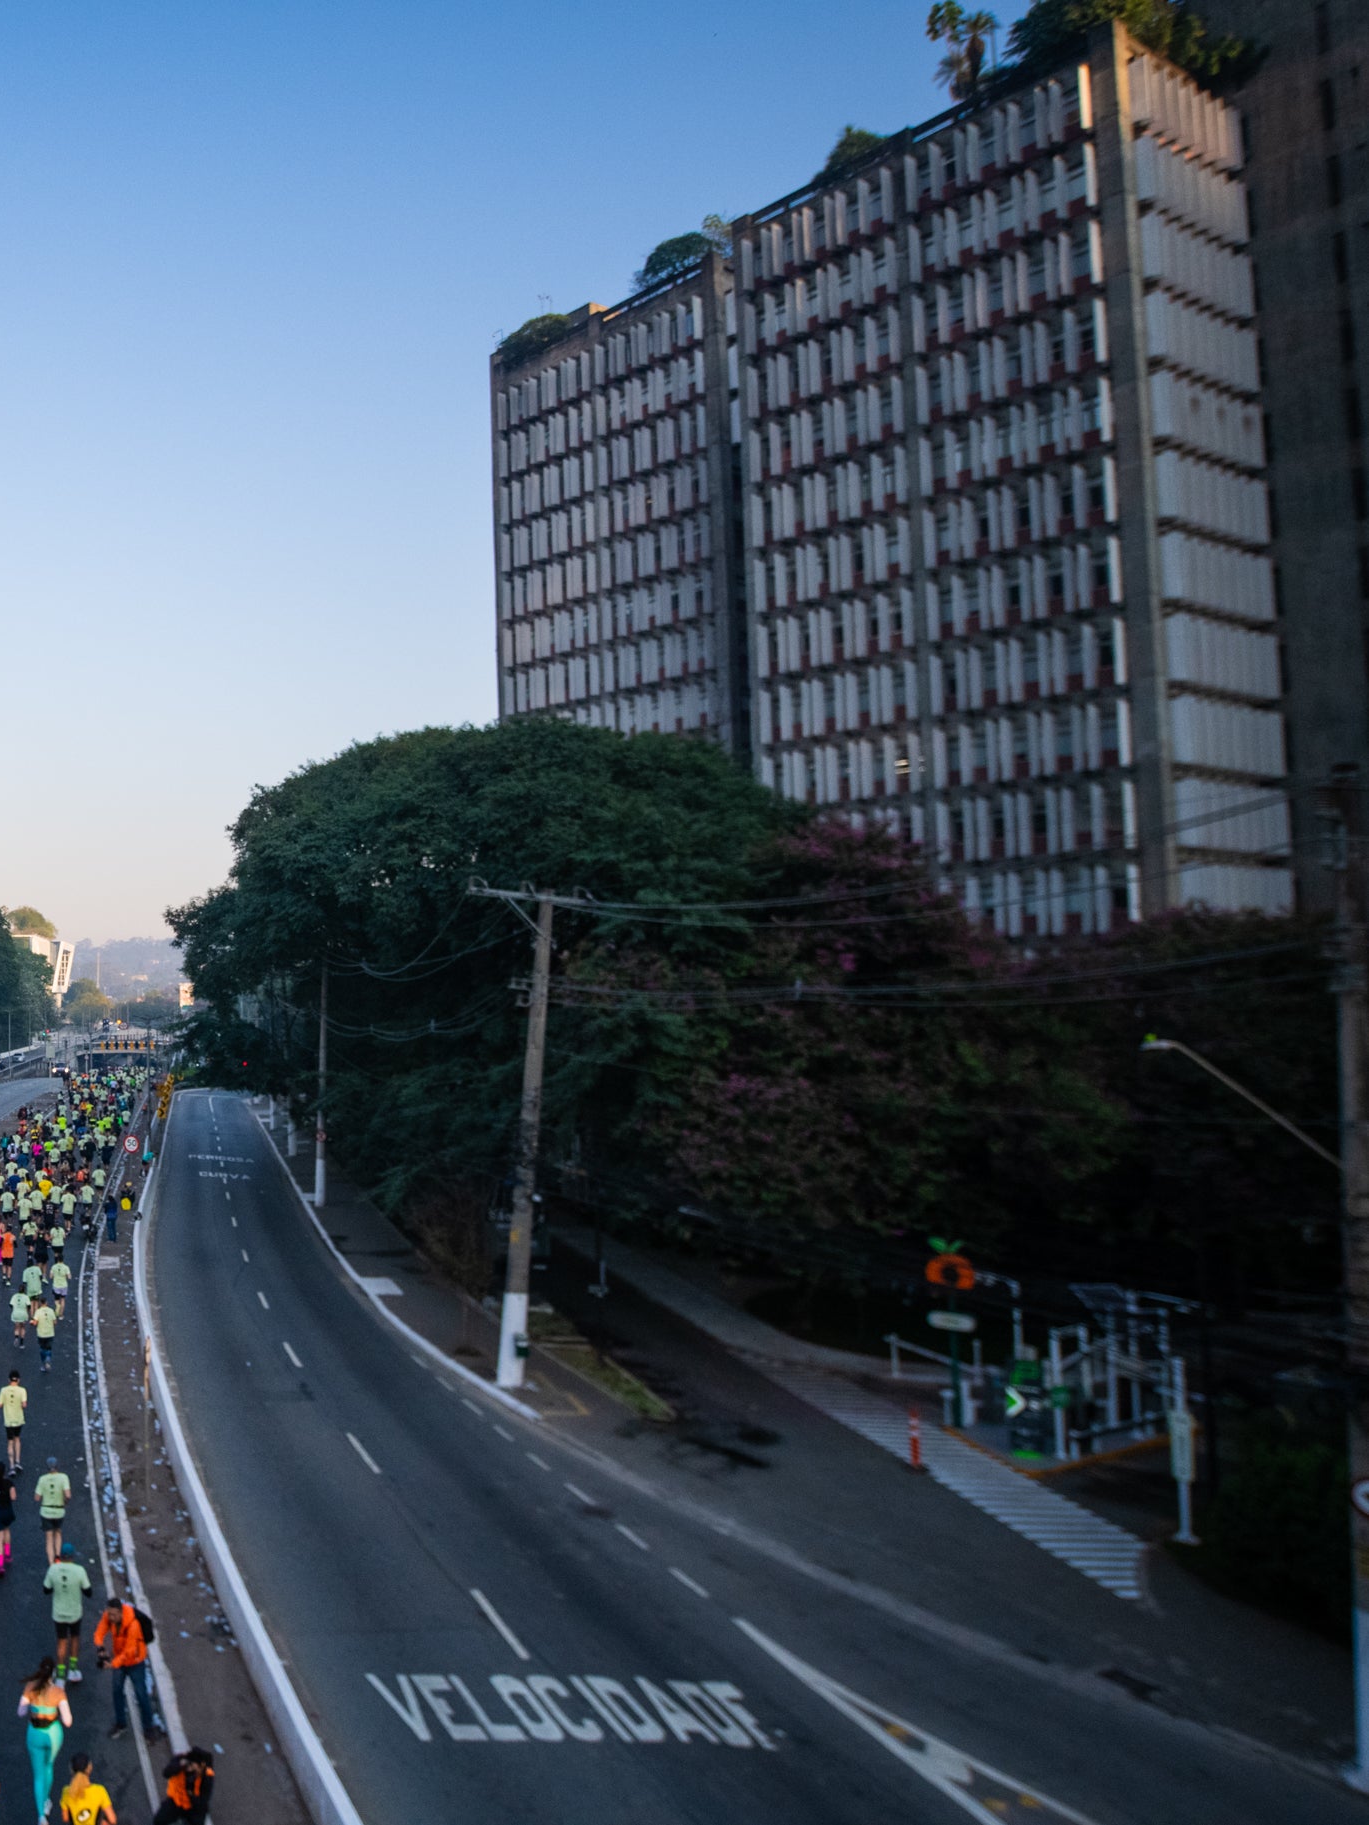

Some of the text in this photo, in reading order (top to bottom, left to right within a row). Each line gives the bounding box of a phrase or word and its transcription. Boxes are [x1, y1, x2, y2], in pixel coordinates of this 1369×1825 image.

[127, 1139, 136, 1147] 50
[199, 1171, 250, 1180] CURVA
[364, 1673, 786, 1751] VELOCIDADE
